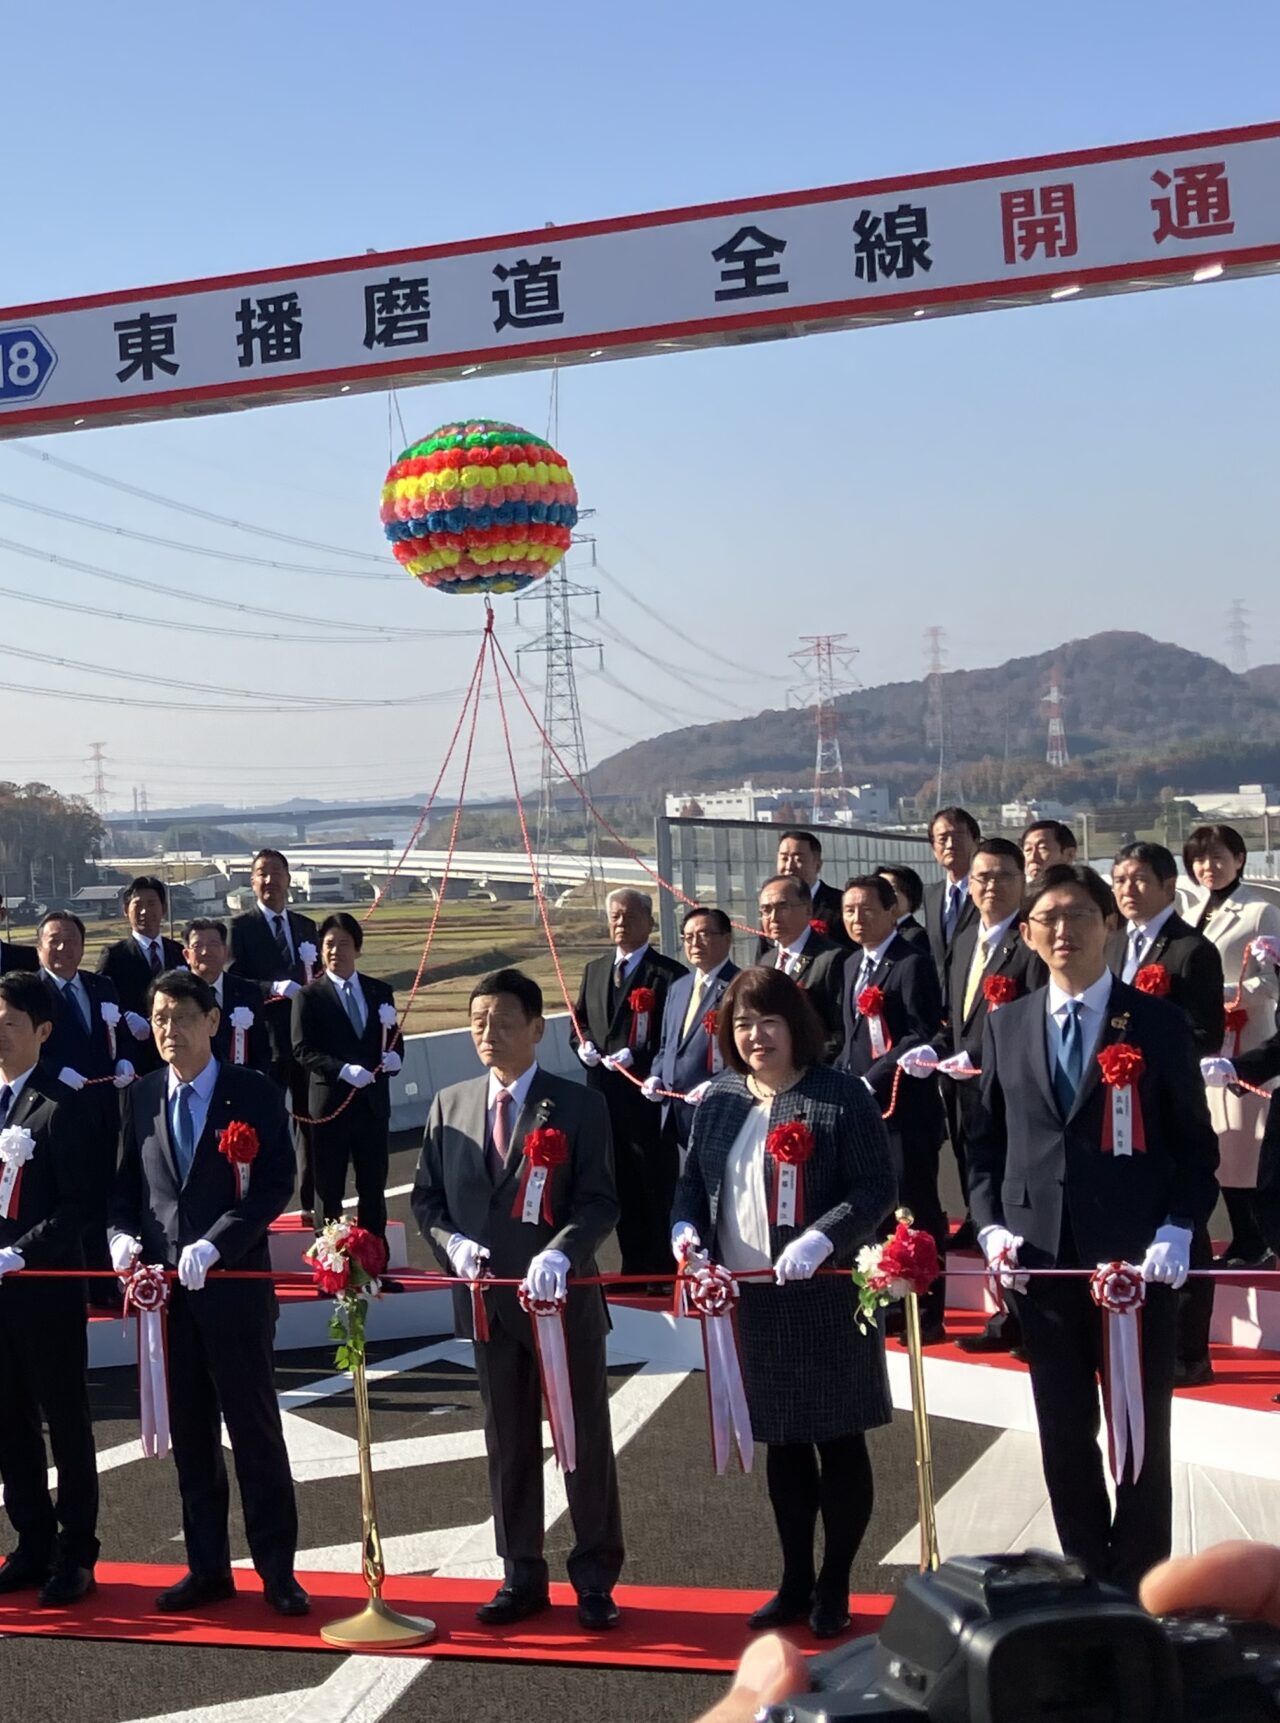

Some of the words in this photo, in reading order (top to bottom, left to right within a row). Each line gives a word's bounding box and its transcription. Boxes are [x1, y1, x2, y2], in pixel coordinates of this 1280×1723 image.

[113, 254, 565, 382] 東播磨道
[711, 161, 1236, 302] 全線開通
